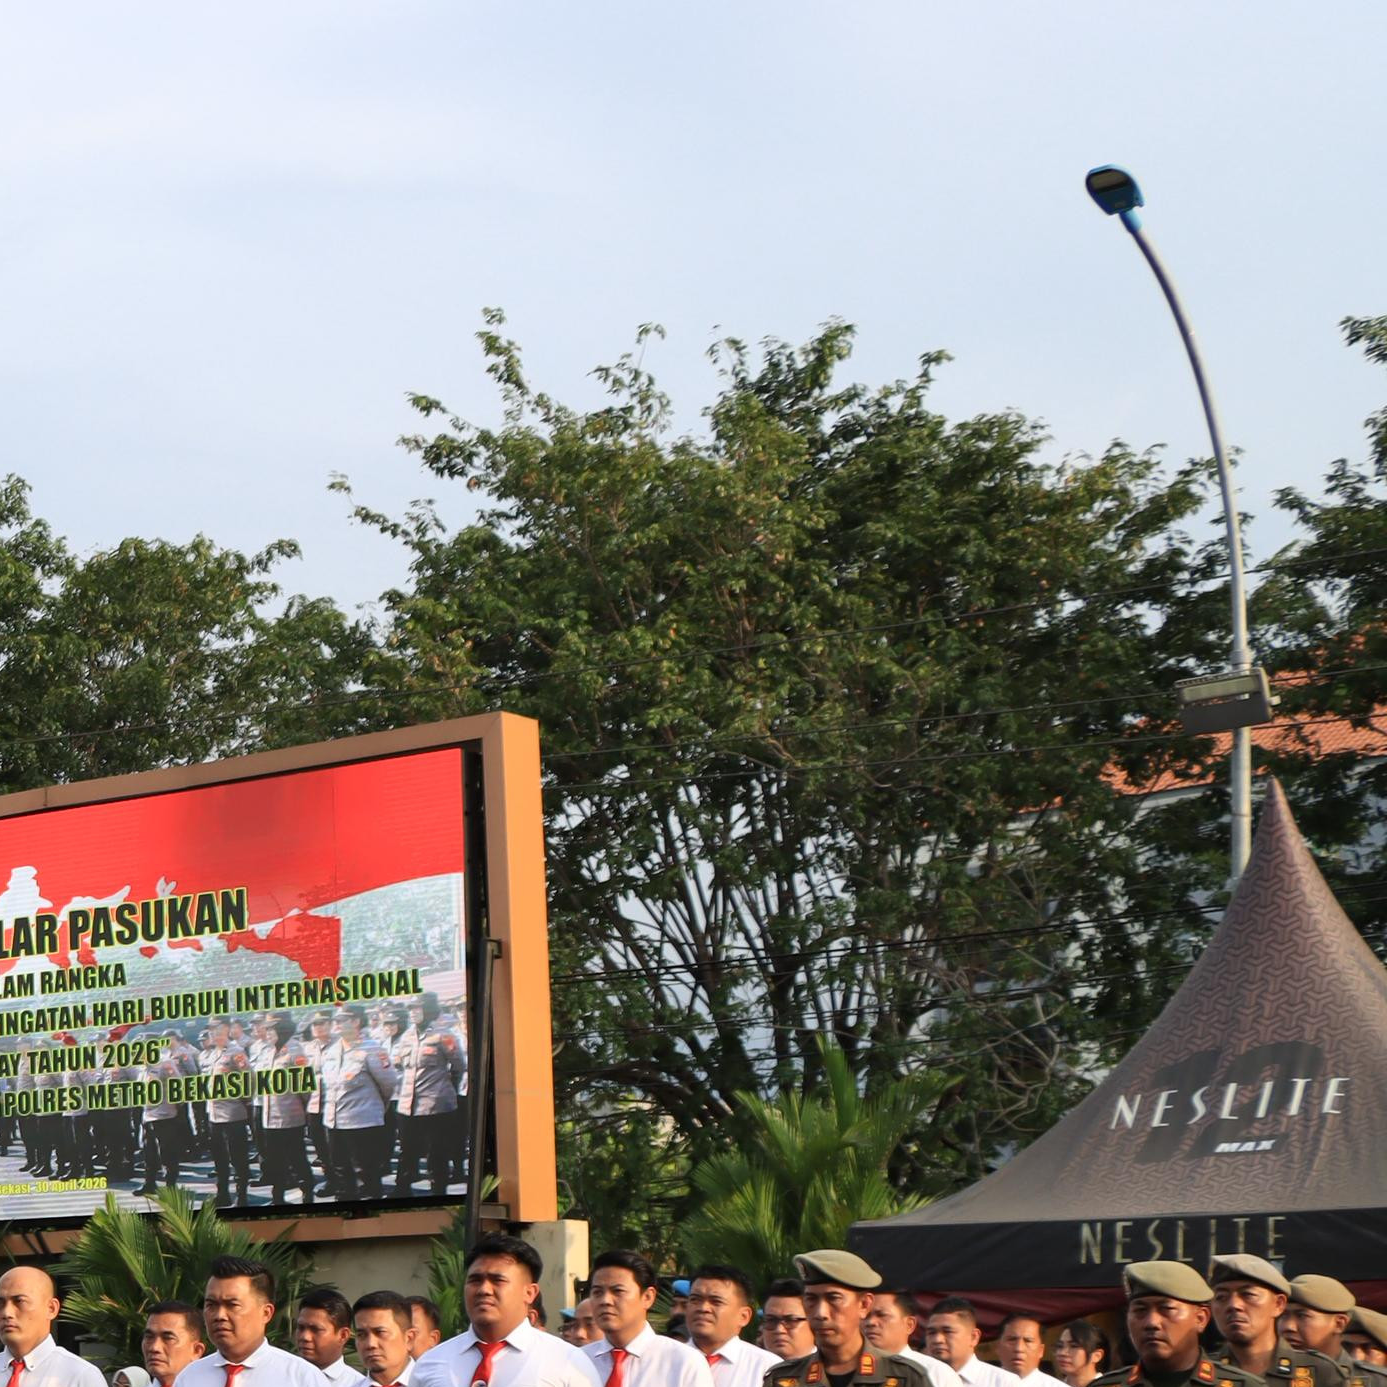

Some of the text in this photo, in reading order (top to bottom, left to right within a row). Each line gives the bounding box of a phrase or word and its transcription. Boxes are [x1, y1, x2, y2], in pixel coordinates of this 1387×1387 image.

[69, 886, 249, 951] PASUKAN
[39, 962, 127, 996] RANGKA
[92, 998, 145, 1027] HARI
[150, 988, 229, 1021] BURUH
[235, 967, 424, 1013] INTERNASIONAL
[26, 1040, 96, 1077] TAHUN
[4, 1086, 83, 1118] POLRES
[87, 1076, 163, 1109] METRO
[167, 1070, 251, 1104] BEKASI
[256, 1065, 318, 1097] KOTA
[1109, 1077, 1351, 1130] NESLITE
[1214, 1139, 1277, 1153] MAX
[78, 1177, 107, 1190] 2026
[1080, 1216, 1287, 1264] NESLITE
